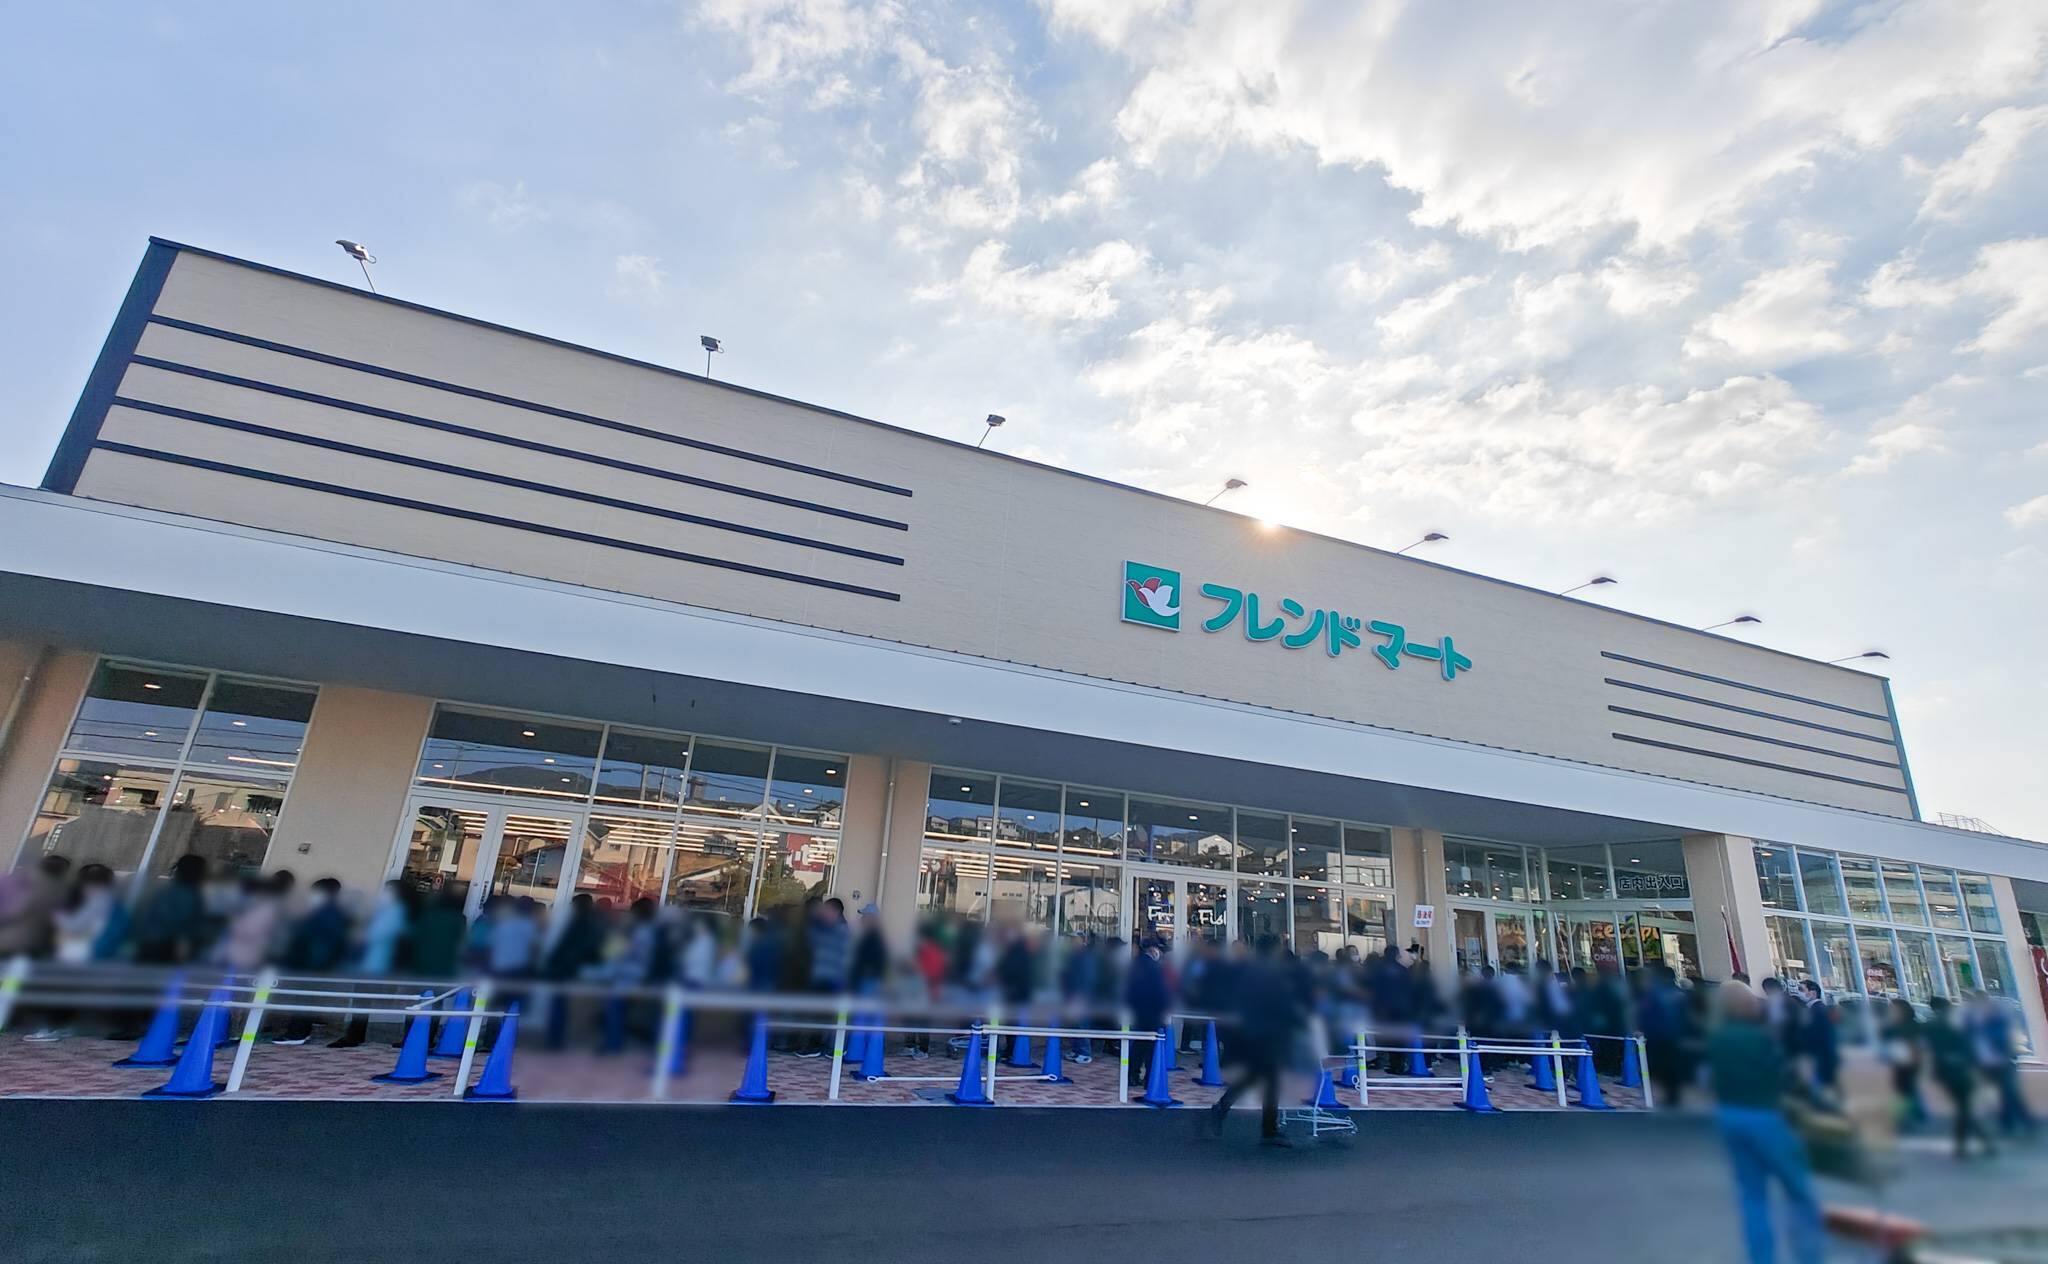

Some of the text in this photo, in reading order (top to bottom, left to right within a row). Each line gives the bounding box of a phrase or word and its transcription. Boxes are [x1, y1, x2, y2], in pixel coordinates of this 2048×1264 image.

[1201, 583, 1473, 681] フレンドマート
[1619, 874, 1684, 891] 店内出入口
